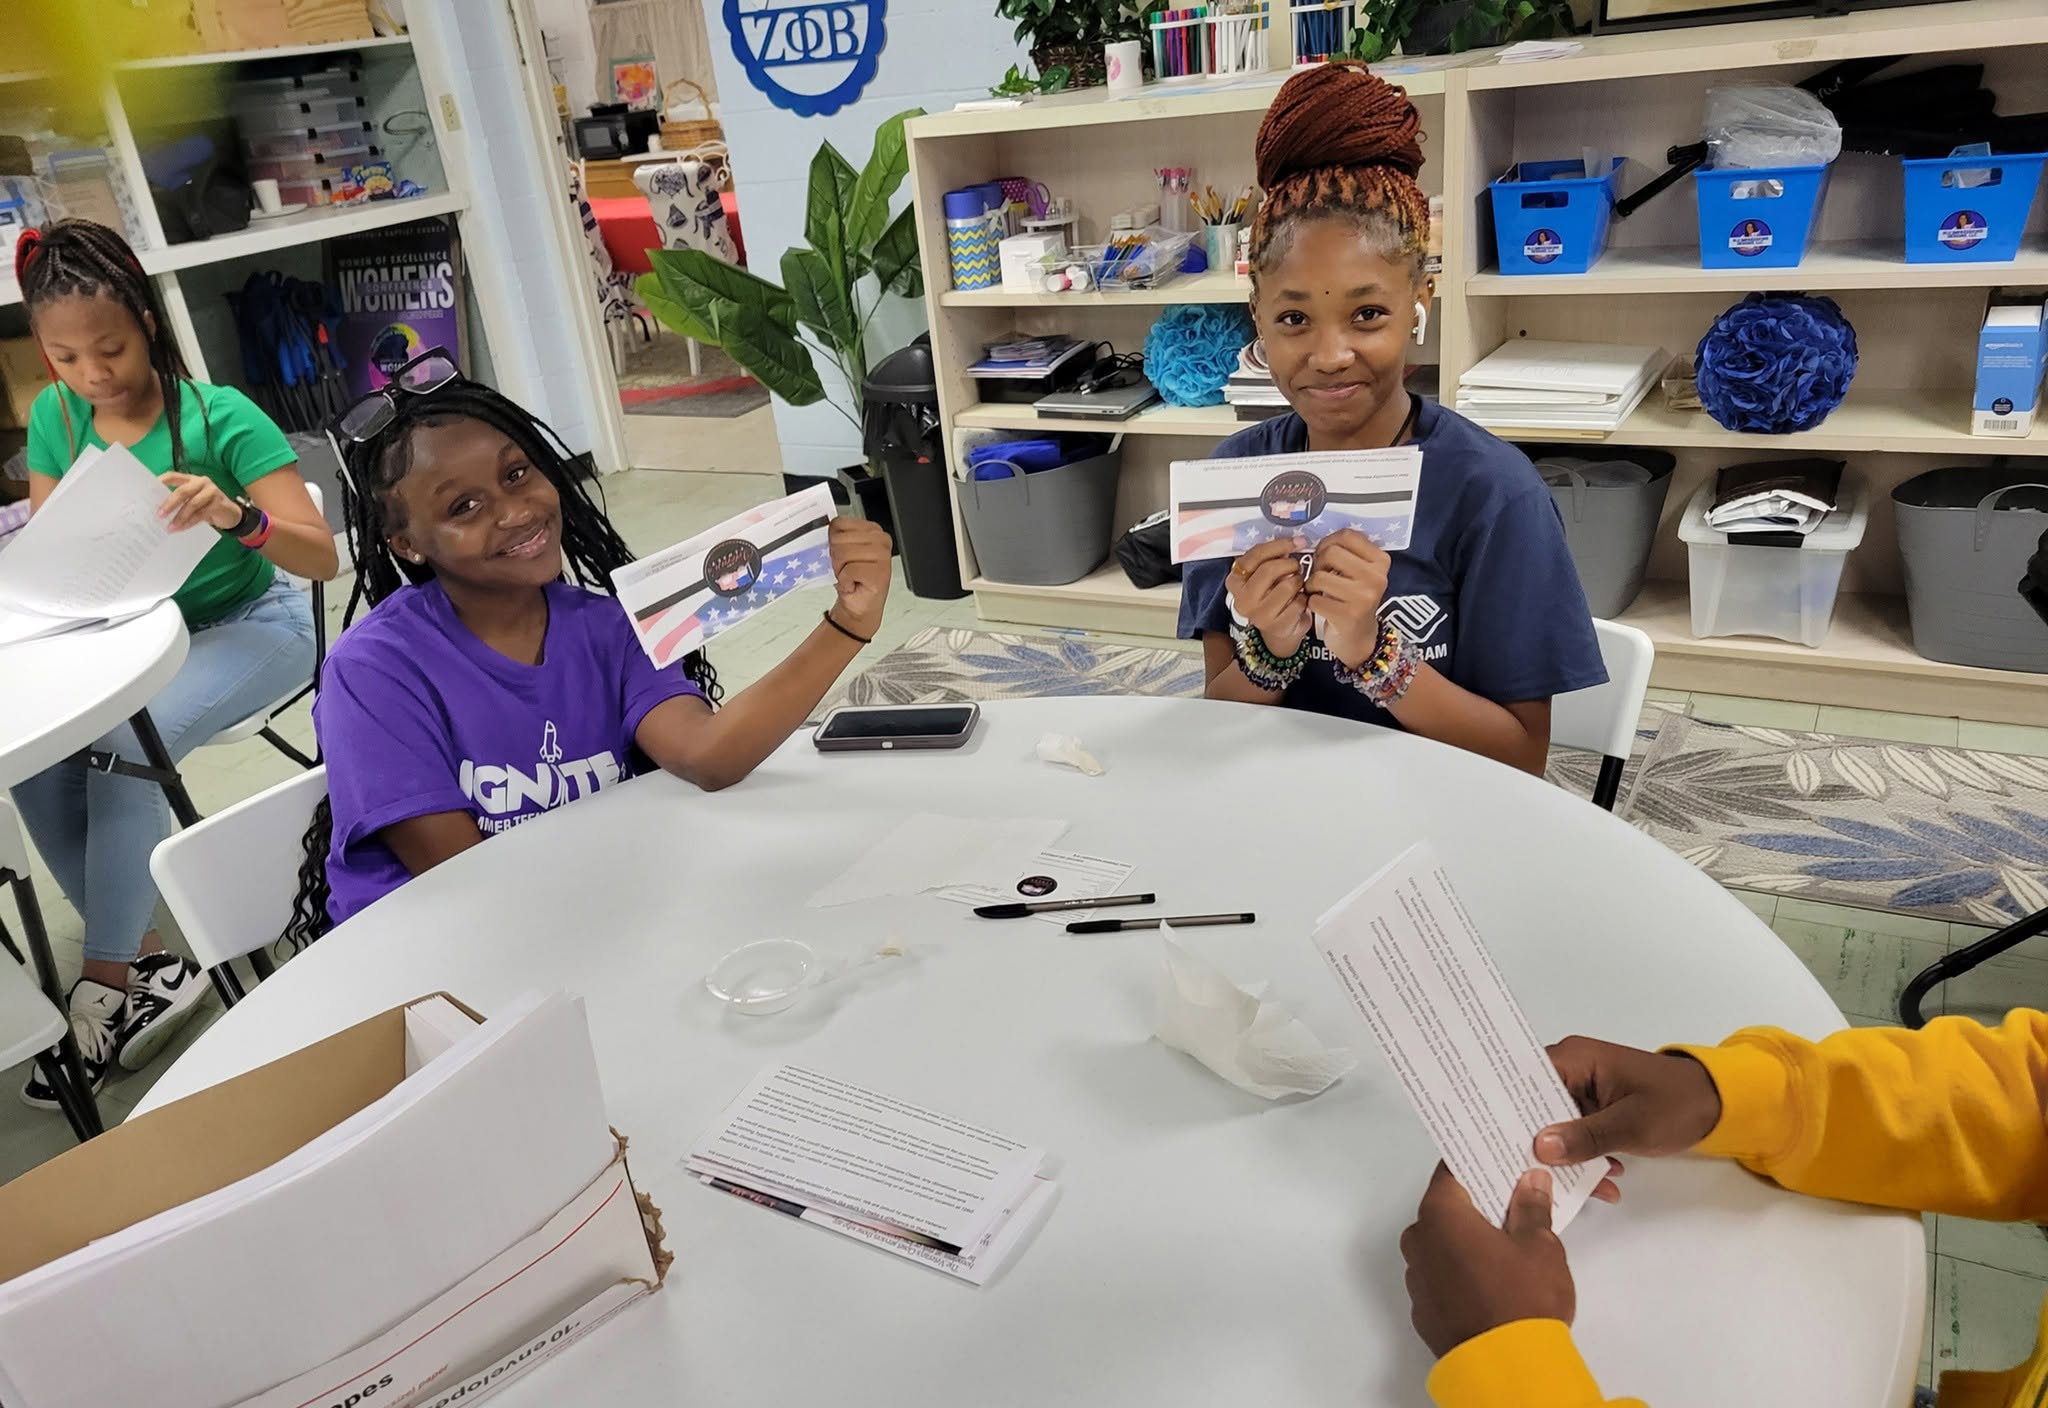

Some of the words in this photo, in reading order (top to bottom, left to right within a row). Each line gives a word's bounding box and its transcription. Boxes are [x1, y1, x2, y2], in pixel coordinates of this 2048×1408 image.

[339, 257, 372, 267] WOMEN
[375, 256, 387, 265] OF
[390, 251, 448, 264] EXCELLENCE
[339, 262, 455, 313] WOMENS
[366, 282, 434, 293] CONFERENCE
[427, 1340, 546, 1408] envelope
